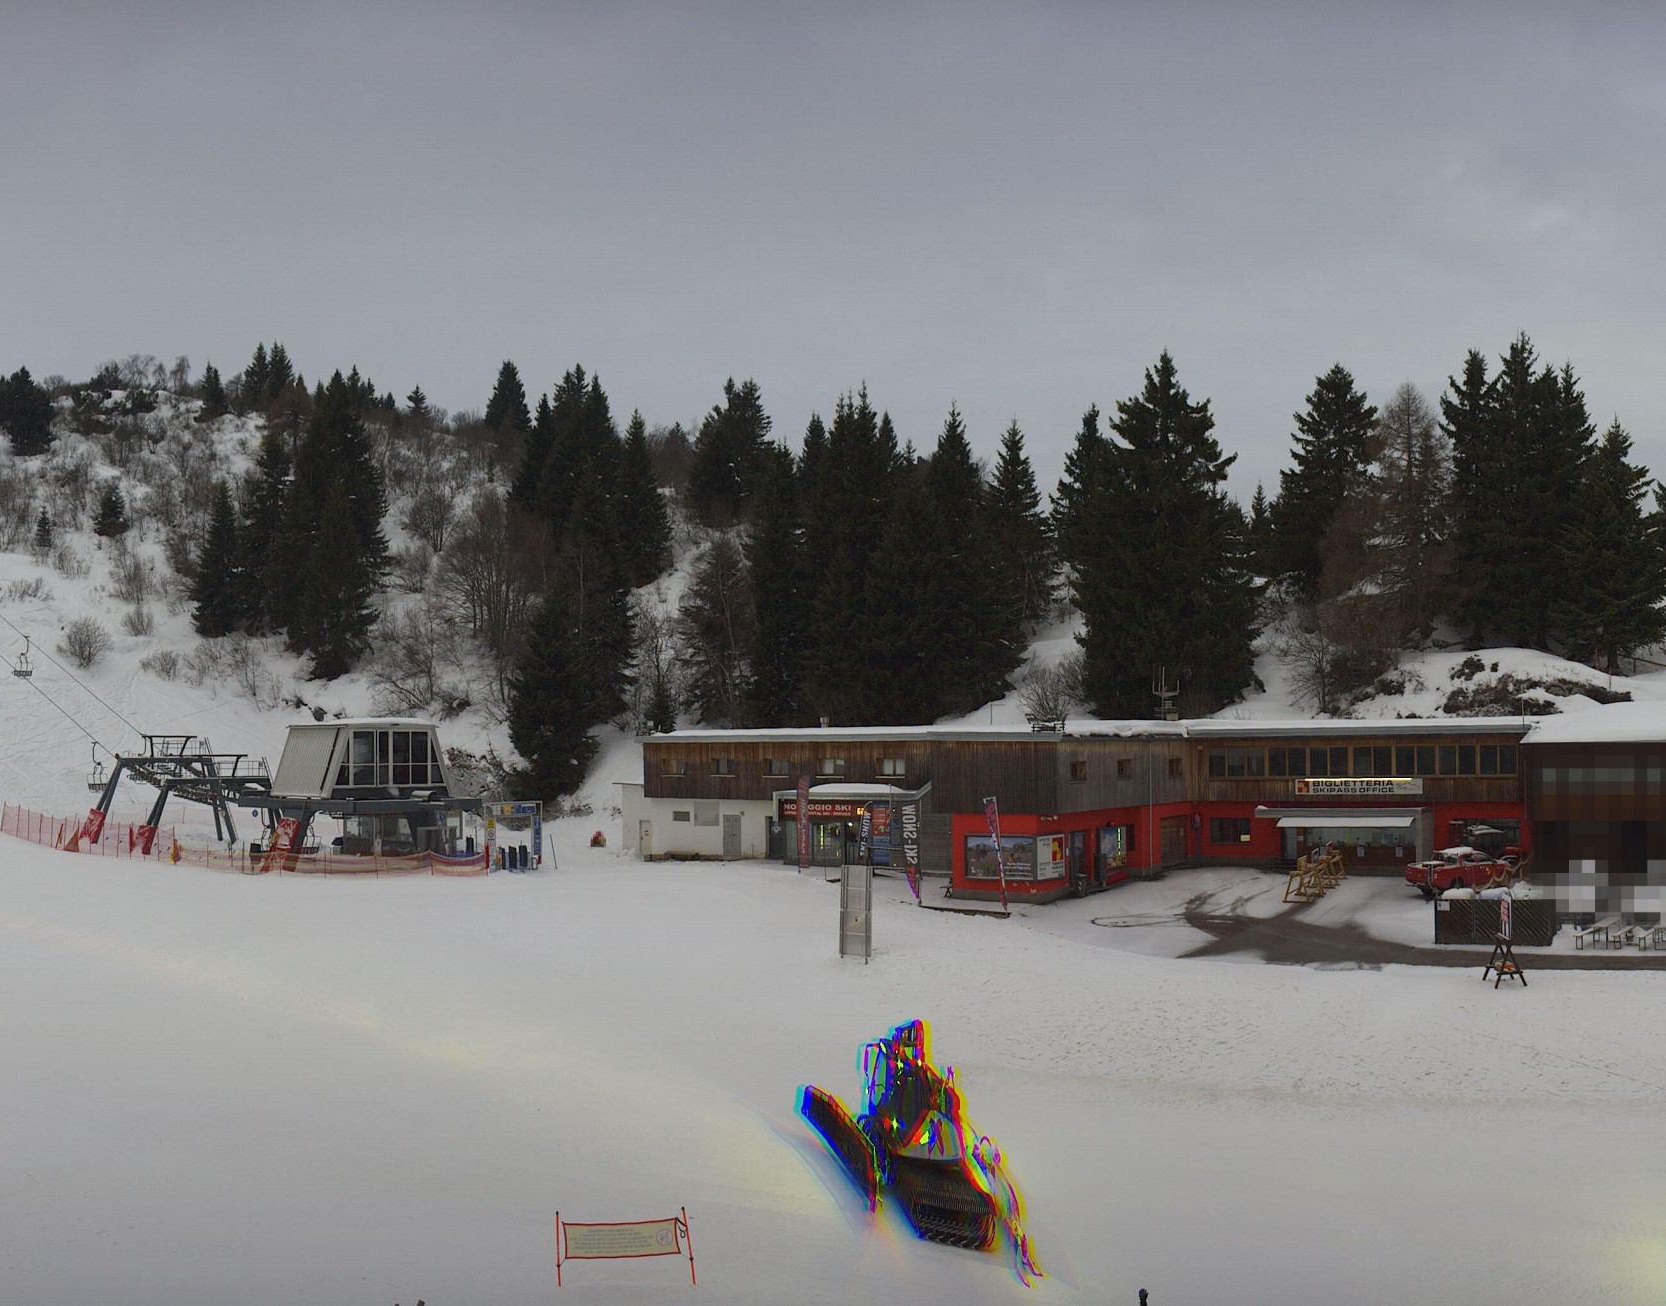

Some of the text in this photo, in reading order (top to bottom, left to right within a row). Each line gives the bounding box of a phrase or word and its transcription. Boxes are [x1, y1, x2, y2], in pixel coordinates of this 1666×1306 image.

[783, 803, 852, 811] NOGGIO SKI
[860, 810, 872, 857] SKI-SNOW
